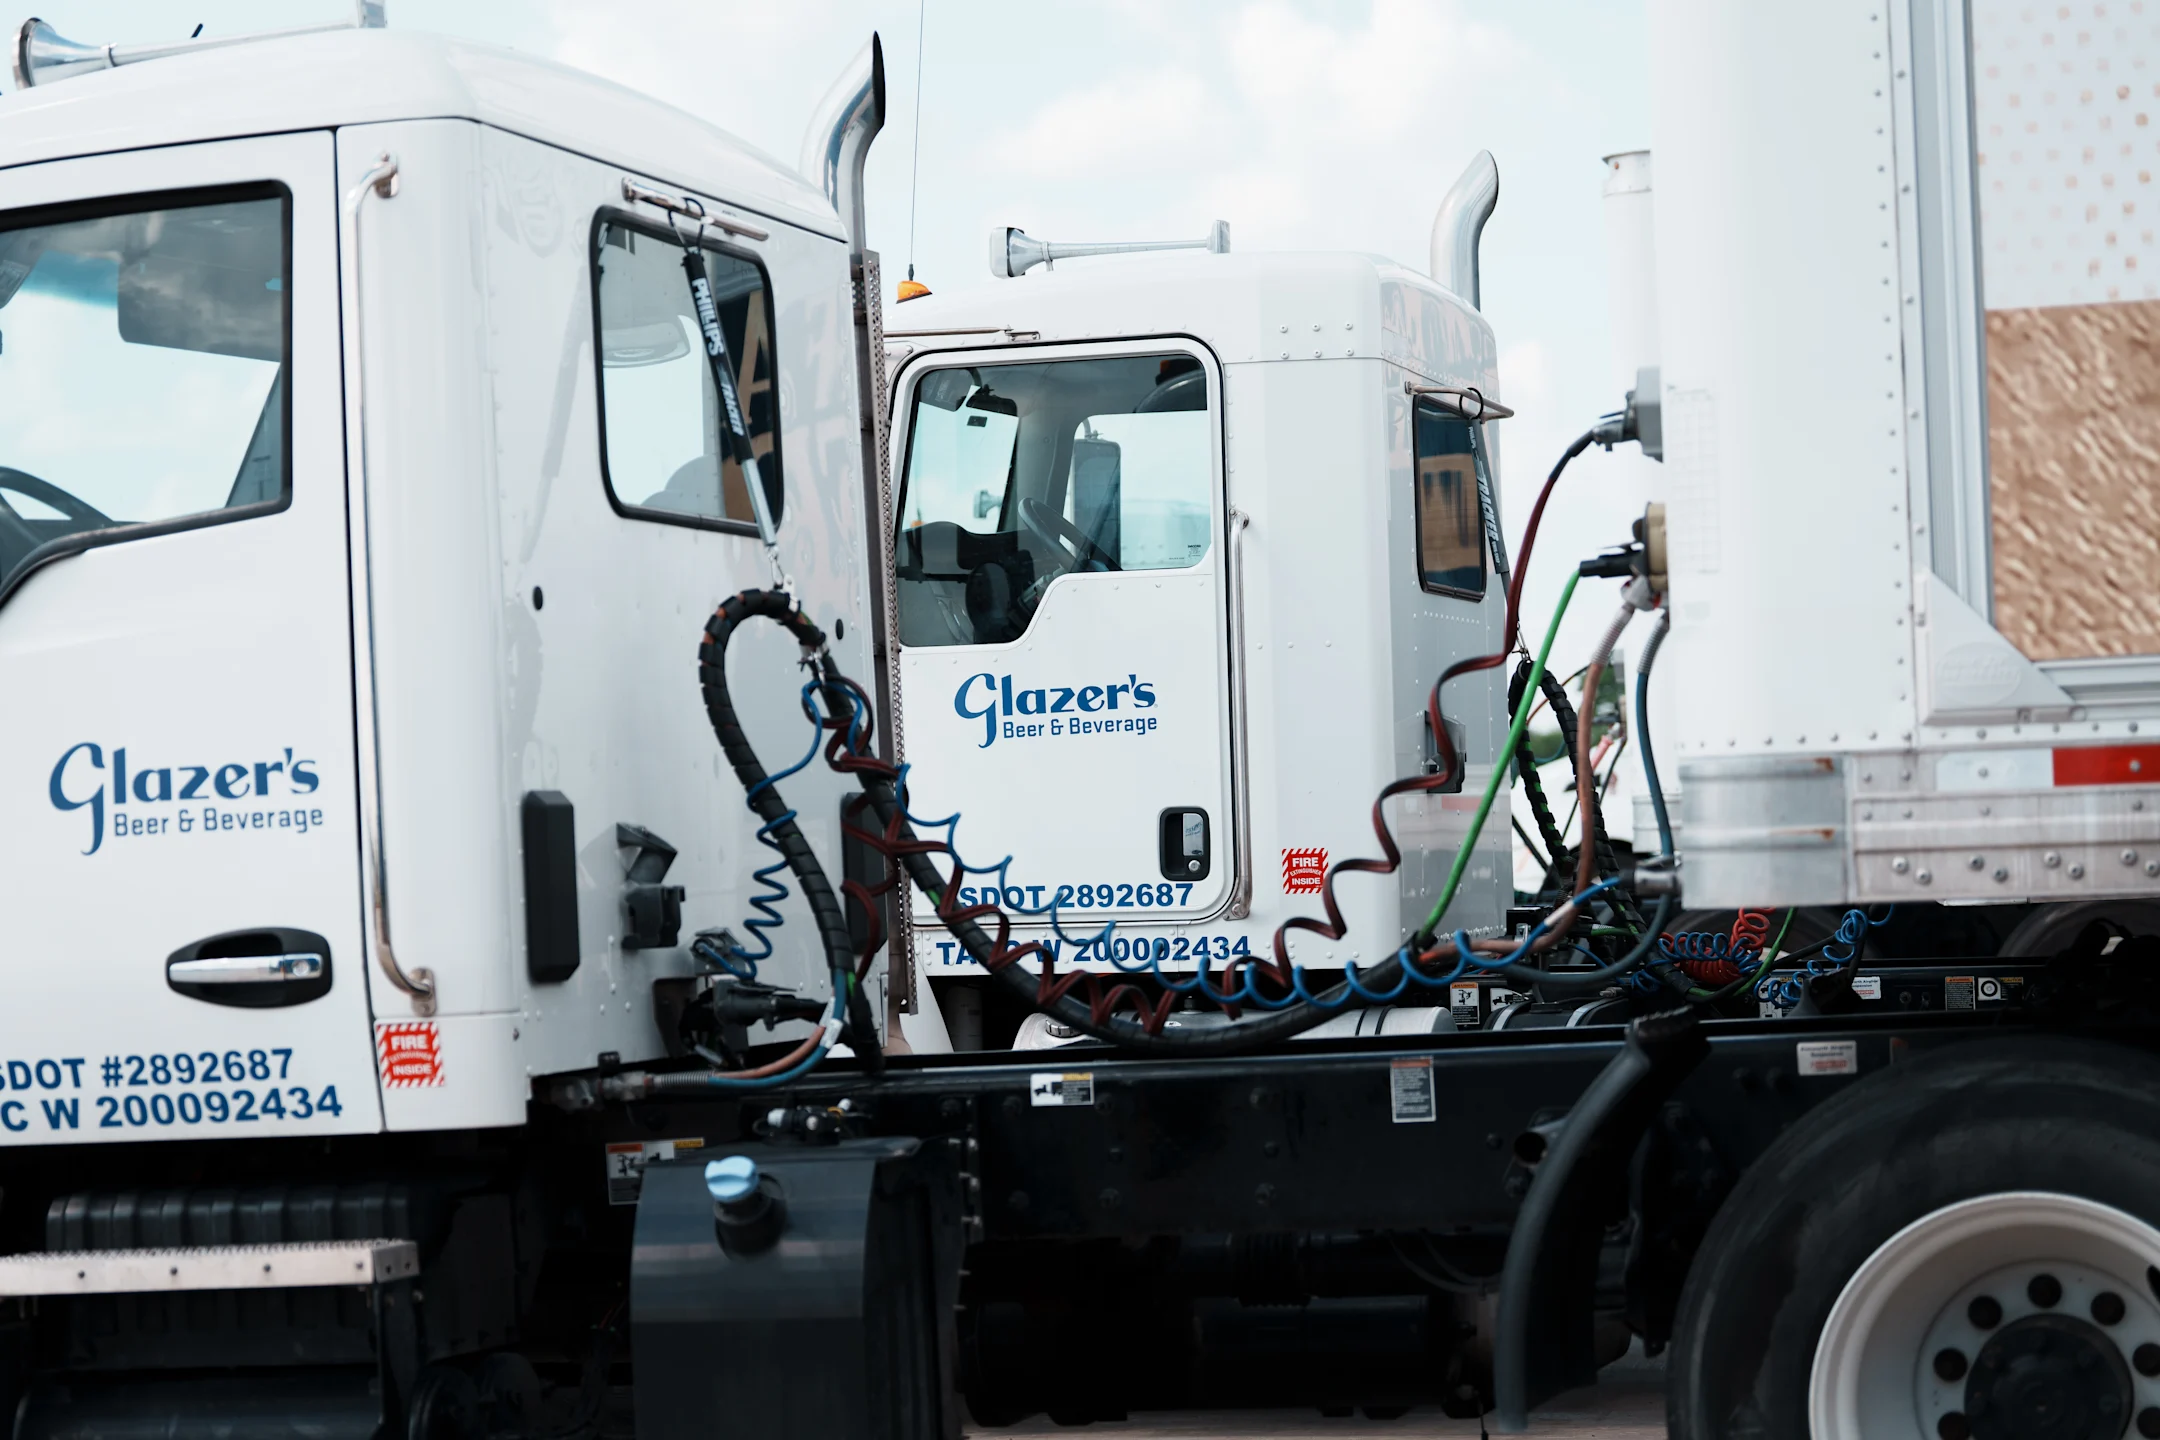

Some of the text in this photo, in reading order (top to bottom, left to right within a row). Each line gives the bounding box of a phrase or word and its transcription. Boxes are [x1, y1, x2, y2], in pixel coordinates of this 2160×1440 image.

[692, 278, 725, 357] PHILLIPS
[720, 382, 744, 436] TRACKER
[1477, 475, 1500, 542] TRACKER
[954, 673, 1156, 748] Glazer's
[1003, 717, 1158, 738] Beer & Beverage
[49, 742, 319, 855] Glazer's
[114, 808, 323, 836] Beer & Beverage
[1292, 857, 1319, 867] FIRE
[1058, 883, 1193, 908] 2892687
[1292, 877, 1321, 885] INSIDE
[390, 1034, 429, 1051] FIRE
[0, 1048, 293, 1092] DOT #2892687
[392, 1063, 432, 1076] INSIDE
[40, 1098, 79, 1130] W
[96, 1085, 342, 1128] 200092434
